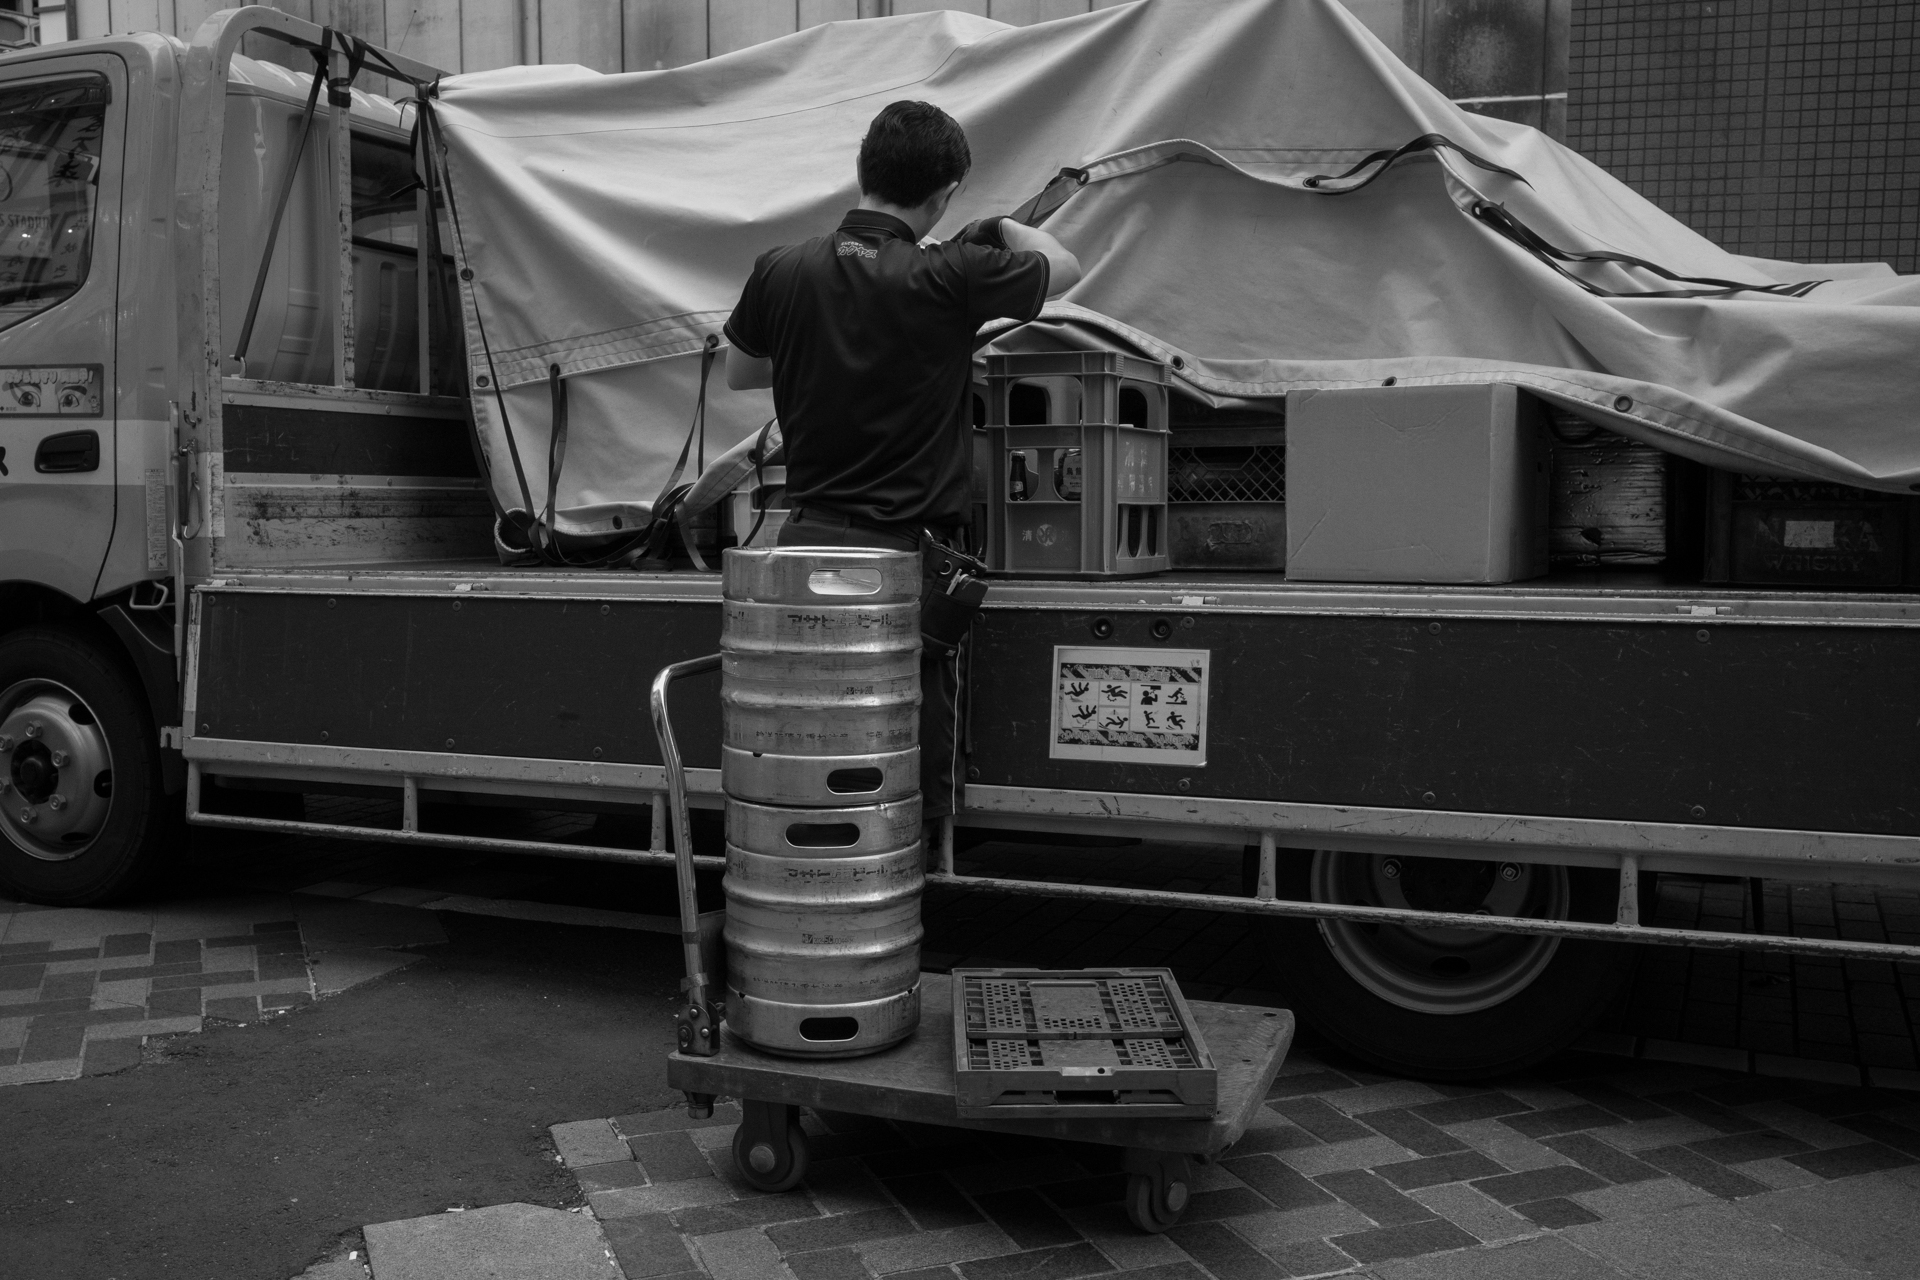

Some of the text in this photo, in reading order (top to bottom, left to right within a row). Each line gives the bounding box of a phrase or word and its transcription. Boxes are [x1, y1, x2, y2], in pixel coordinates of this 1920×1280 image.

[836, 245, 878, 259] カクヤス
[1752, 518, 1882, 553] NKA
[1763, 554, 1864, 572] WHISKY
[1108, 731, 1144, 743] DANGER
